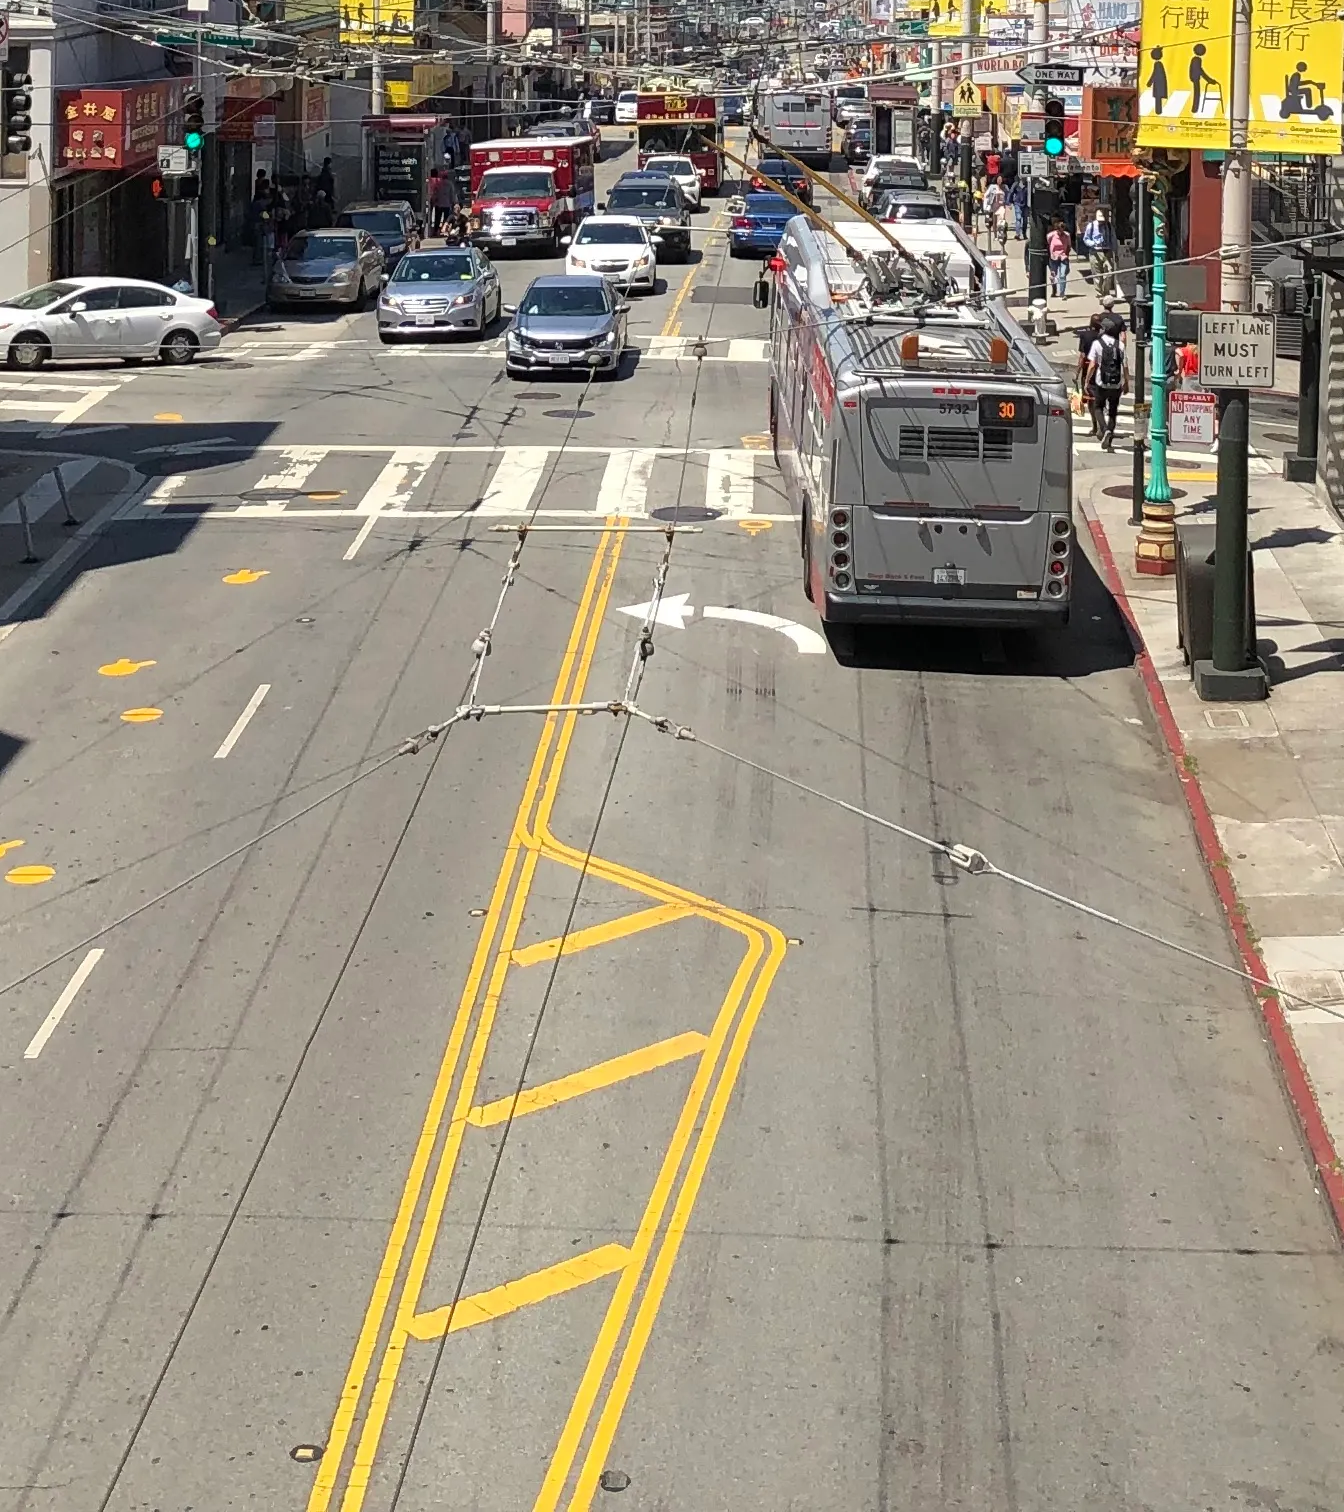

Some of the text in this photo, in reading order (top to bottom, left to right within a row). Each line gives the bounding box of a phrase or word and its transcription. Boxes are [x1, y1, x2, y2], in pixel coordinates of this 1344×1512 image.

[1160, 5, 1209, 30] 行駛
[1255, 26, 1310, 51] 通行
[1035, 70, 1076, 80] ONE WAY
[1205, 322, 1271, 336] LEFT LANE
[1213, 343, 1259, 358] MUST
[1204, 365, 1269, 378] TURN LEFT
[939, 403, 970, 414] 5732
[998, 401, 1015, 419] 30
[1171, 401, 1183, 412] NO
[1184, 415, 1201, 423] ANY
[1183, 425, 1202, 434] TIME
